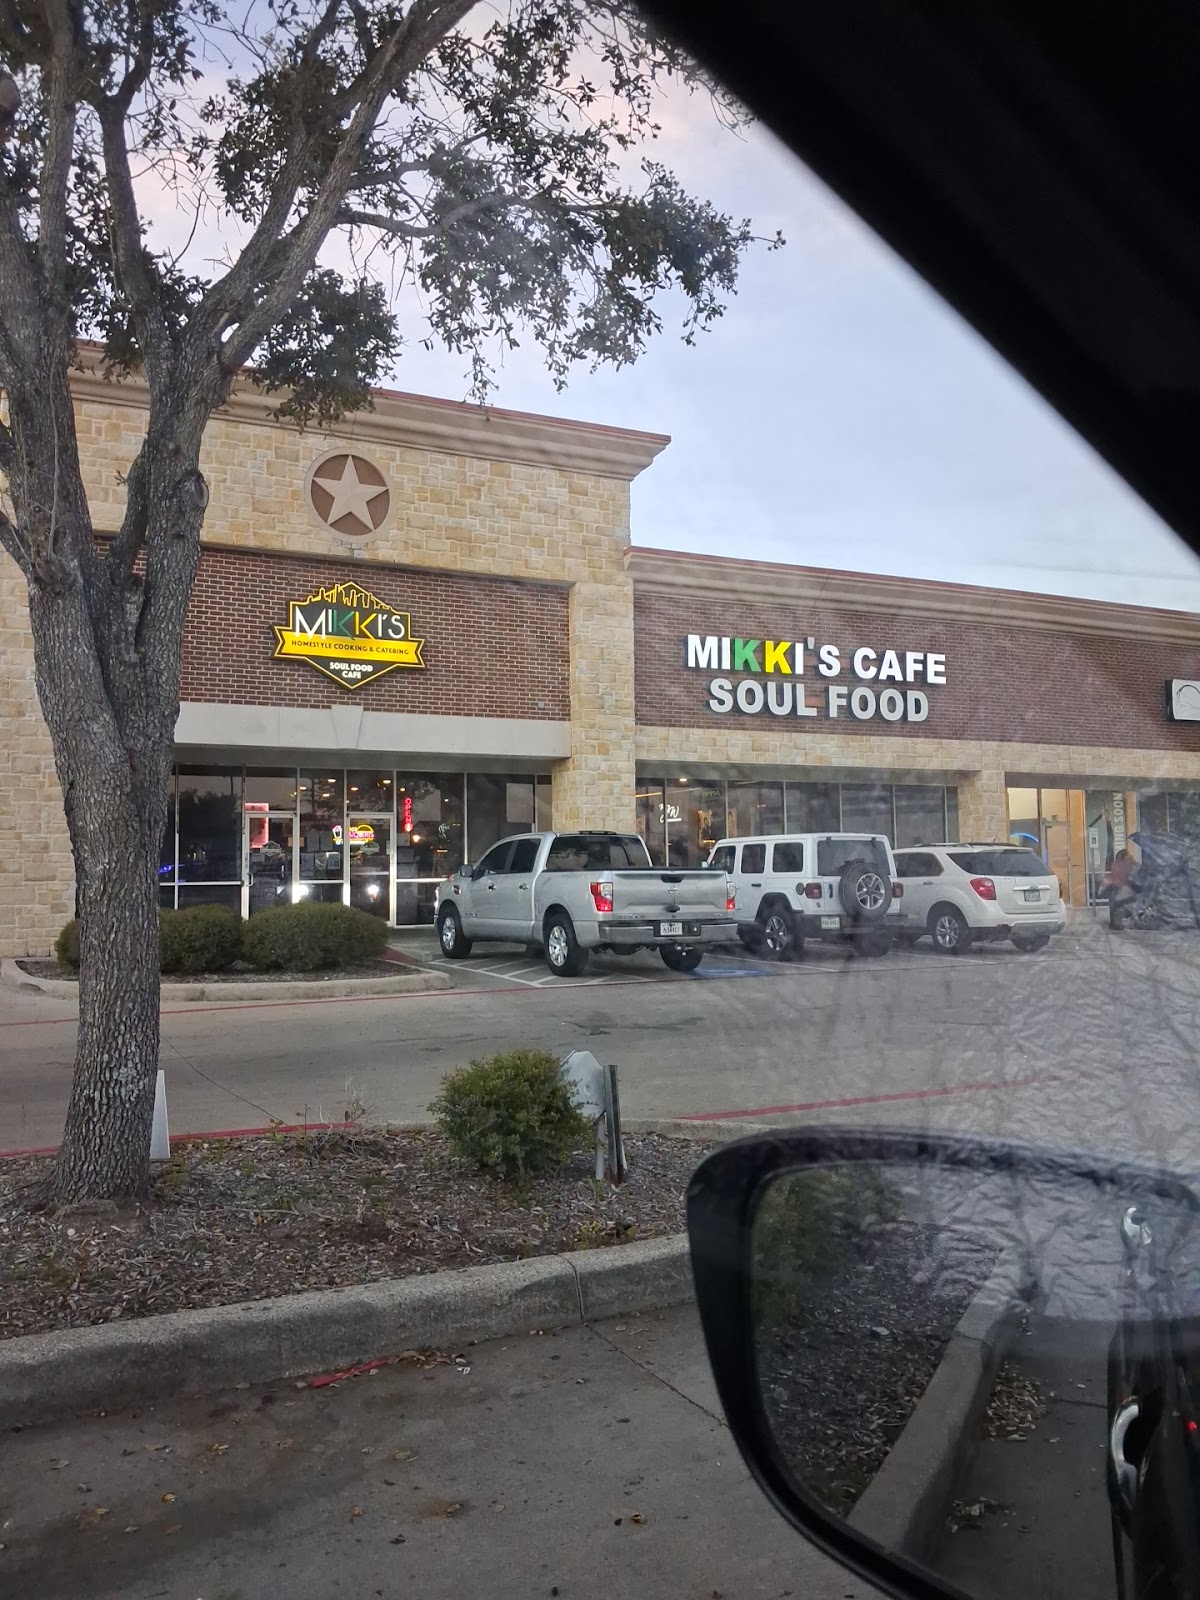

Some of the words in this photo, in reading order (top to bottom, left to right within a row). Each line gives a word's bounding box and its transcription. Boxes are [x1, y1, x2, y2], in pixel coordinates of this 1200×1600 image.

[295, 606, 405, 640] MIKKI'S
[291, 640, 332, 649] HOMESTYLE
[334, 643, 368, 652] COOKING
[375, 647, 409, 655] CATERING
[687, 634, 841, 677] MIKKI'S
[853, 647, 947, 684] CAFE
[329, 662, 350, 670] SOUL
[350, 664, 374, 672] FOOD
[341, 671, 362, 679] CAFE
[709, 678, 818, 717] SOUL
[828, 685, 930, 722] FOOD
[404, 797, 412, 823] OPEN
[1113, 792, 1124, 823] SOON
